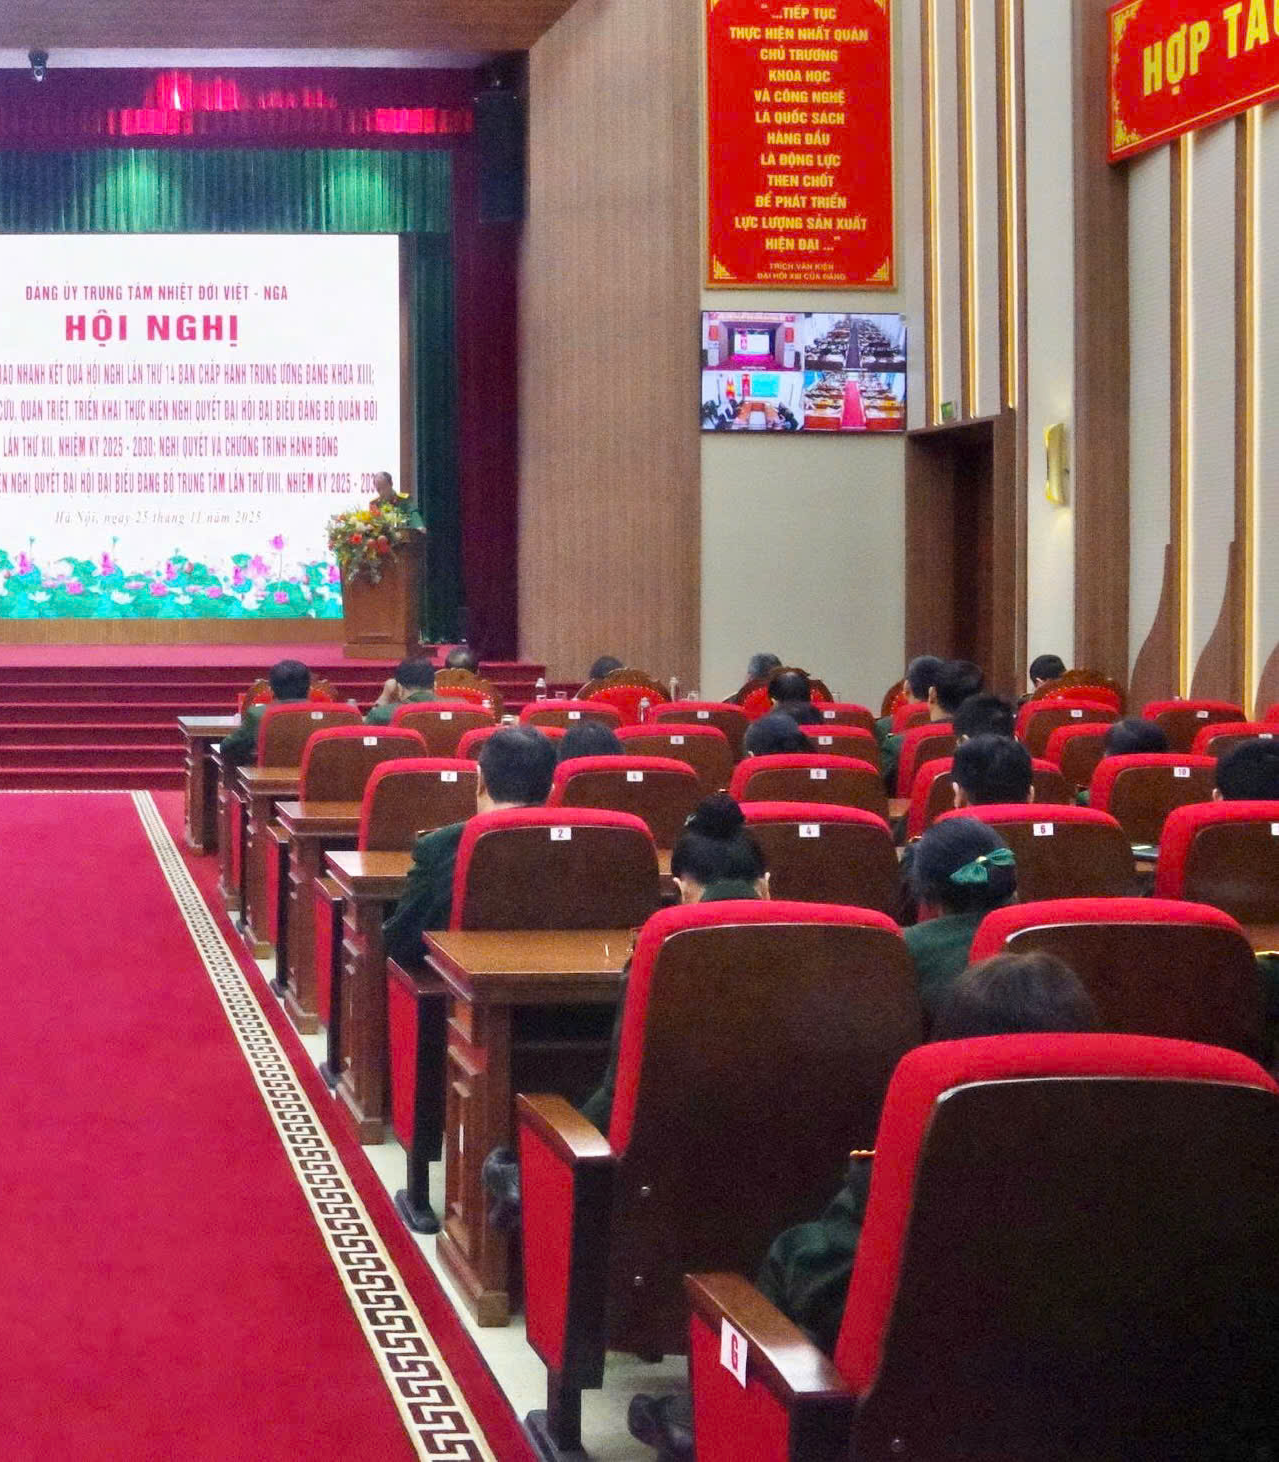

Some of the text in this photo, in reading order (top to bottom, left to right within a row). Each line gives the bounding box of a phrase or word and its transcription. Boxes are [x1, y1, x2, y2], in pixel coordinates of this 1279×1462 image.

[1143, 20, 1211, 97] HỢP
[768, 69, 803, 82] KHOA
[766, 174, 800, 188] THEN
[83, 284, 122, 301] TRUNG
[264, 284, 289, 301] NGA
[64, 309, 239, 348] HỘI NGHỊ
[16, 364, 46, 384] NHANH
[165, 365, 176, 384] 14
[177, 364, 196, 384] BAN
[249, 364, 277, 384] TRUNG
[100, 400, 122, 420] KHAI
[102, 436, 124, 457] 2025
[177, 472, 206, 493] TRUNG
[330, 472, 352, 493] 2025
[730, 1333, 738, 1371] 6
